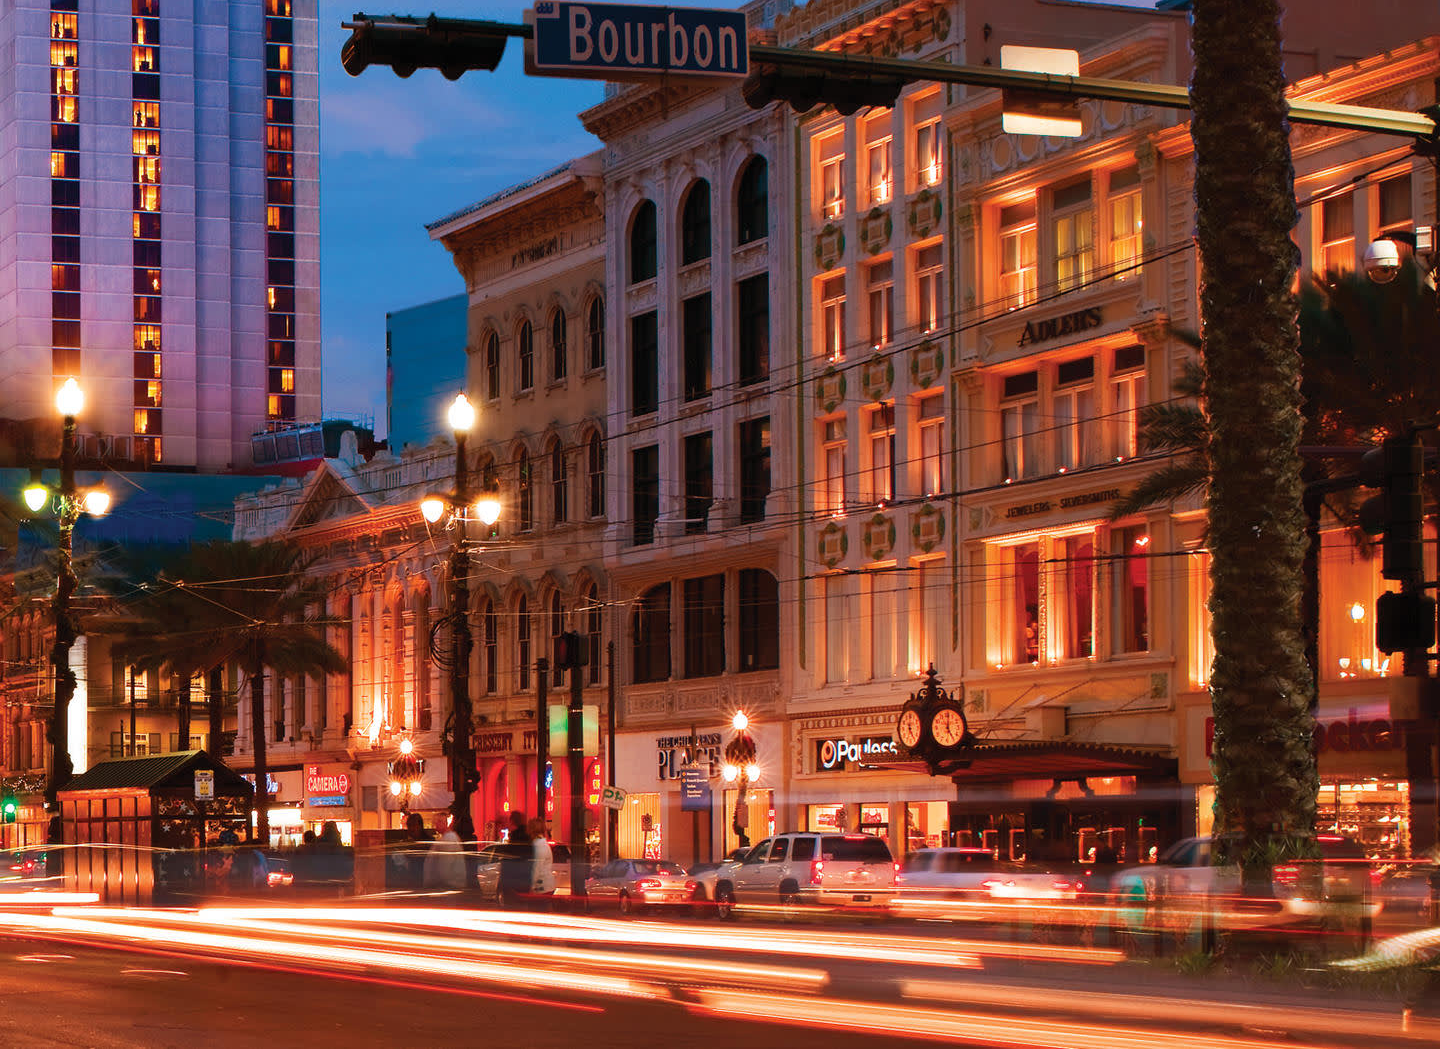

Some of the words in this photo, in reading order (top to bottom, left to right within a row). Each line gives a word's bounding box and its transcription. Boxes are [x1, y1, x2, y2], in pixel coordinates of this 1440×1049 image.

[568, 5, 738, 69] Bourbon
[656, 737, 672, 748] THE
[672, 733, 721, 747] CHILREN'S
[308, 776, 338, 792] CAMERA
